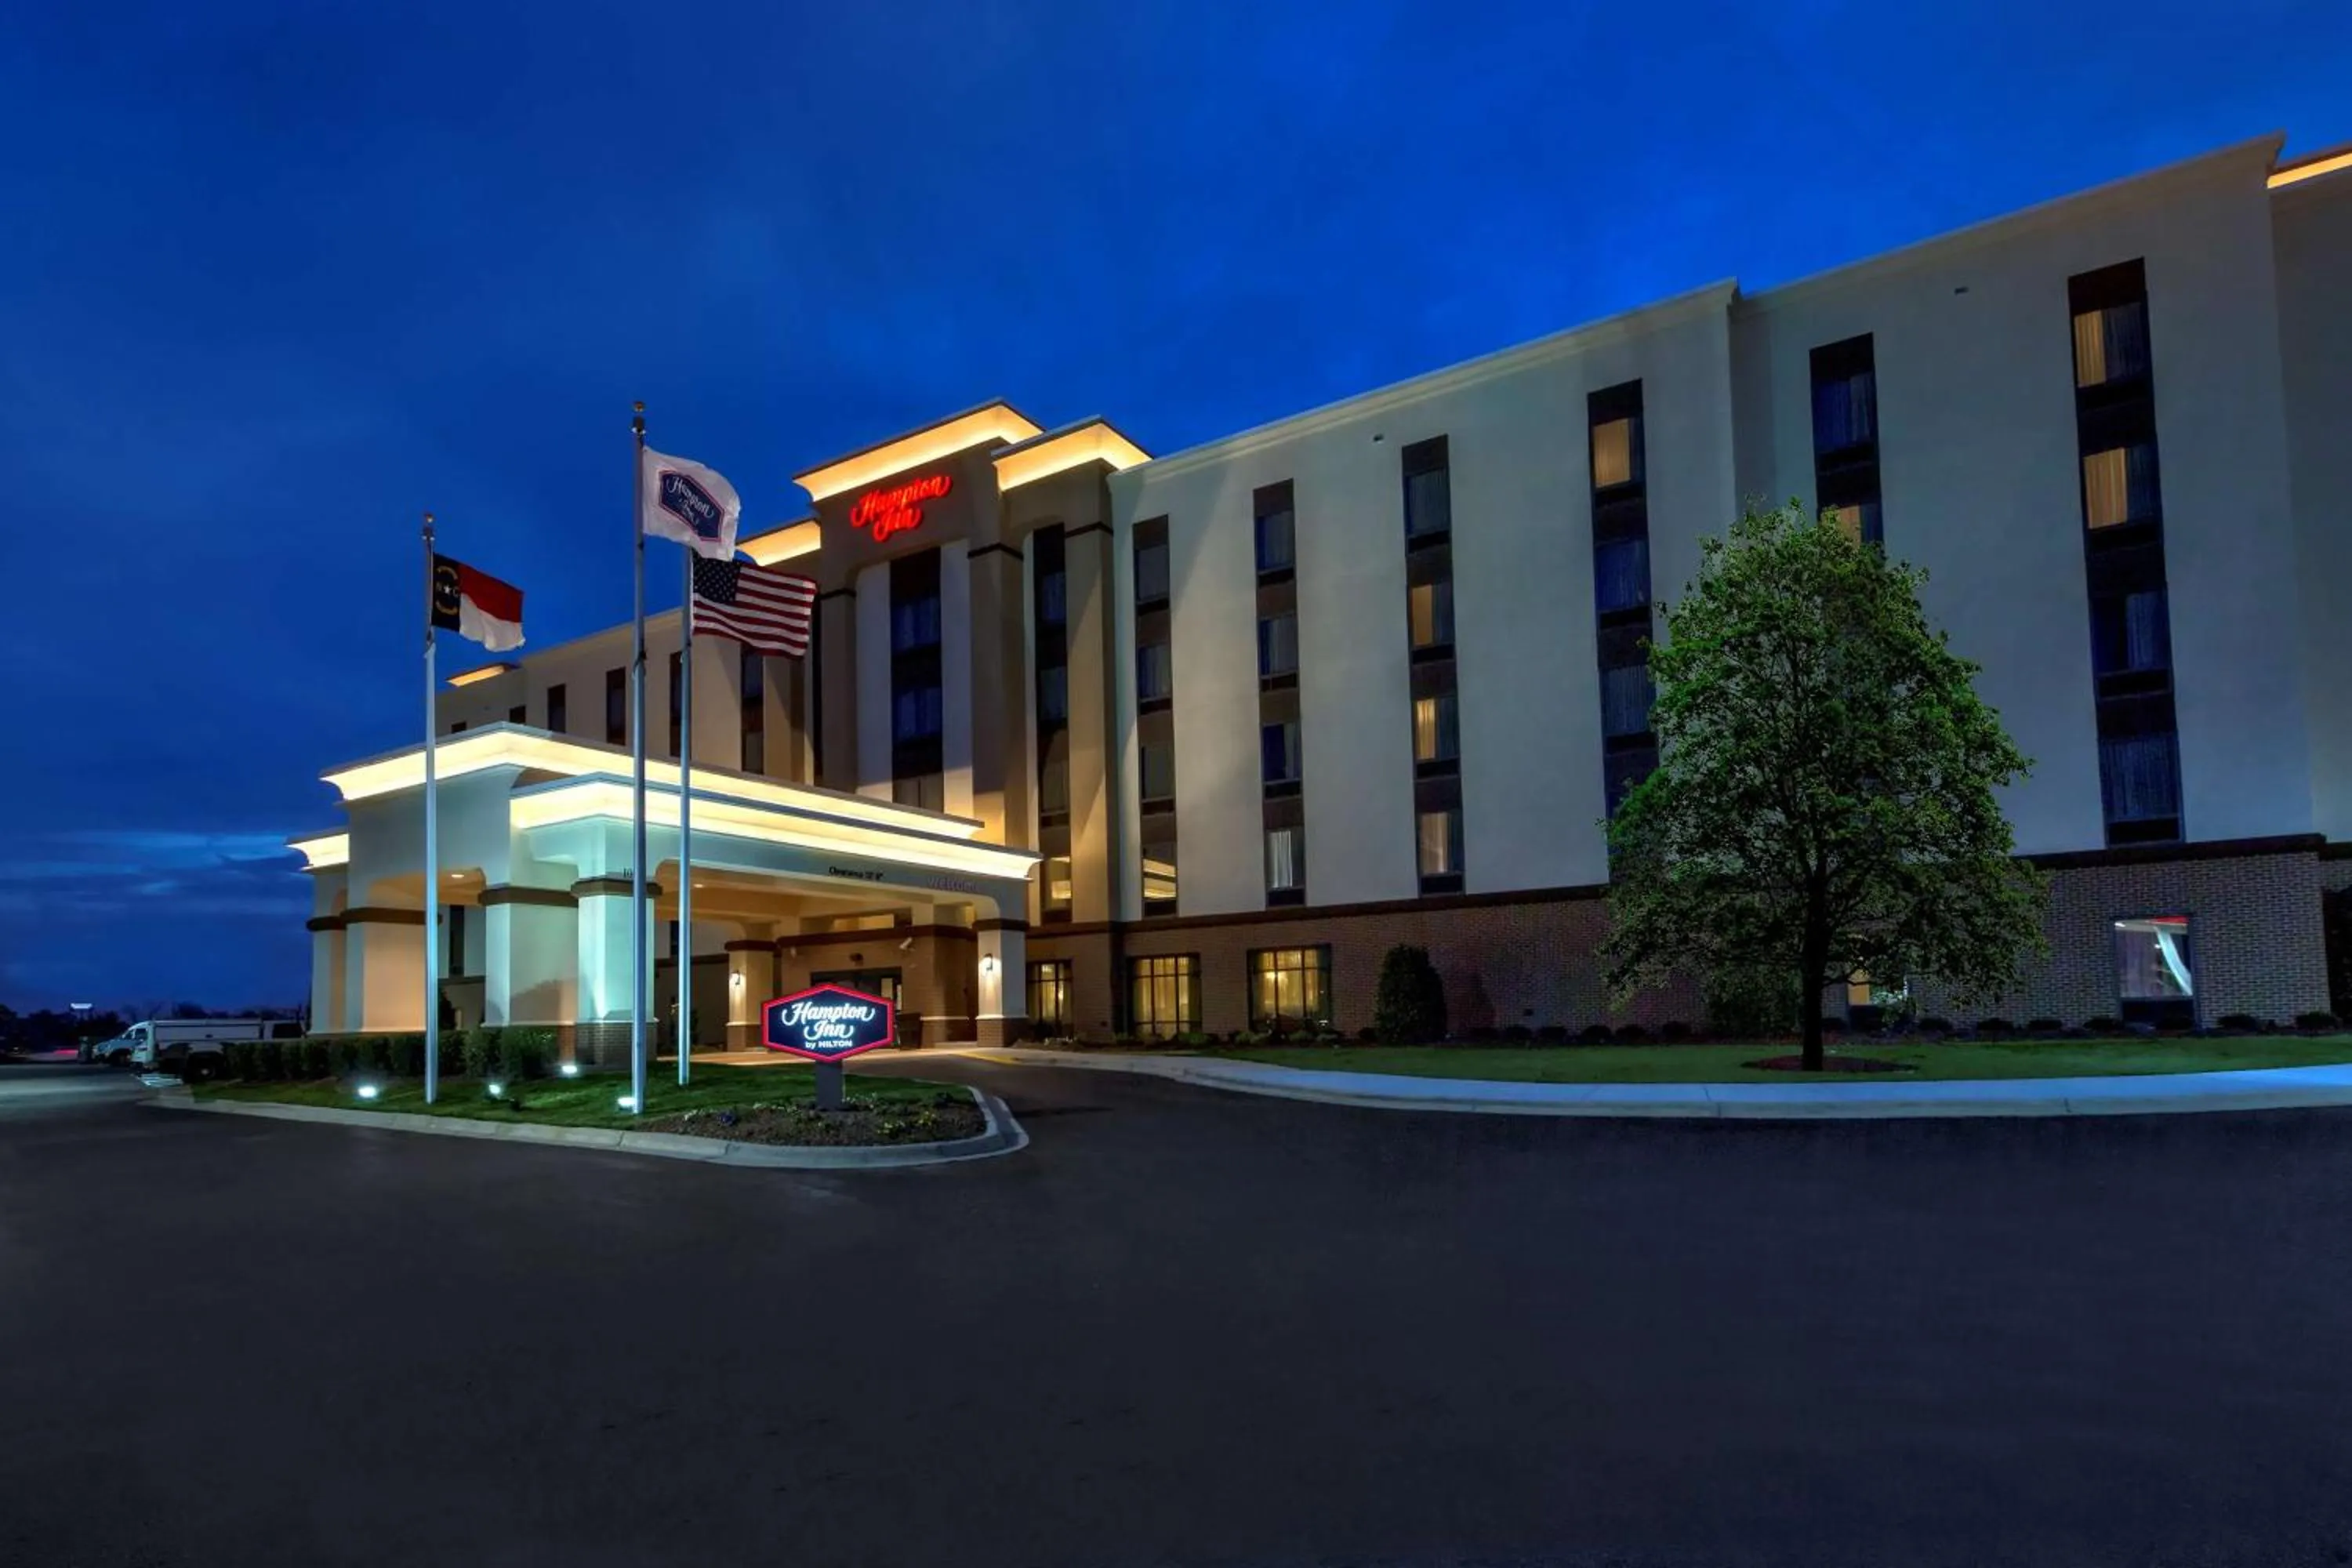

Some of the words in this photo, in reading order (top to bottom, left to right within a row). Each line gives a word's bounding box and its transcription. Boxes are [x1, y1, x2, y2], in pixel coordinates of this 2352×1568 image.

[850, 475, 952, 528] Hampton
[873, 508, 922, 542] Inn
[782, 1000, 875, 1026] Hampton
[804, 1020, 855, 1040] Inn
